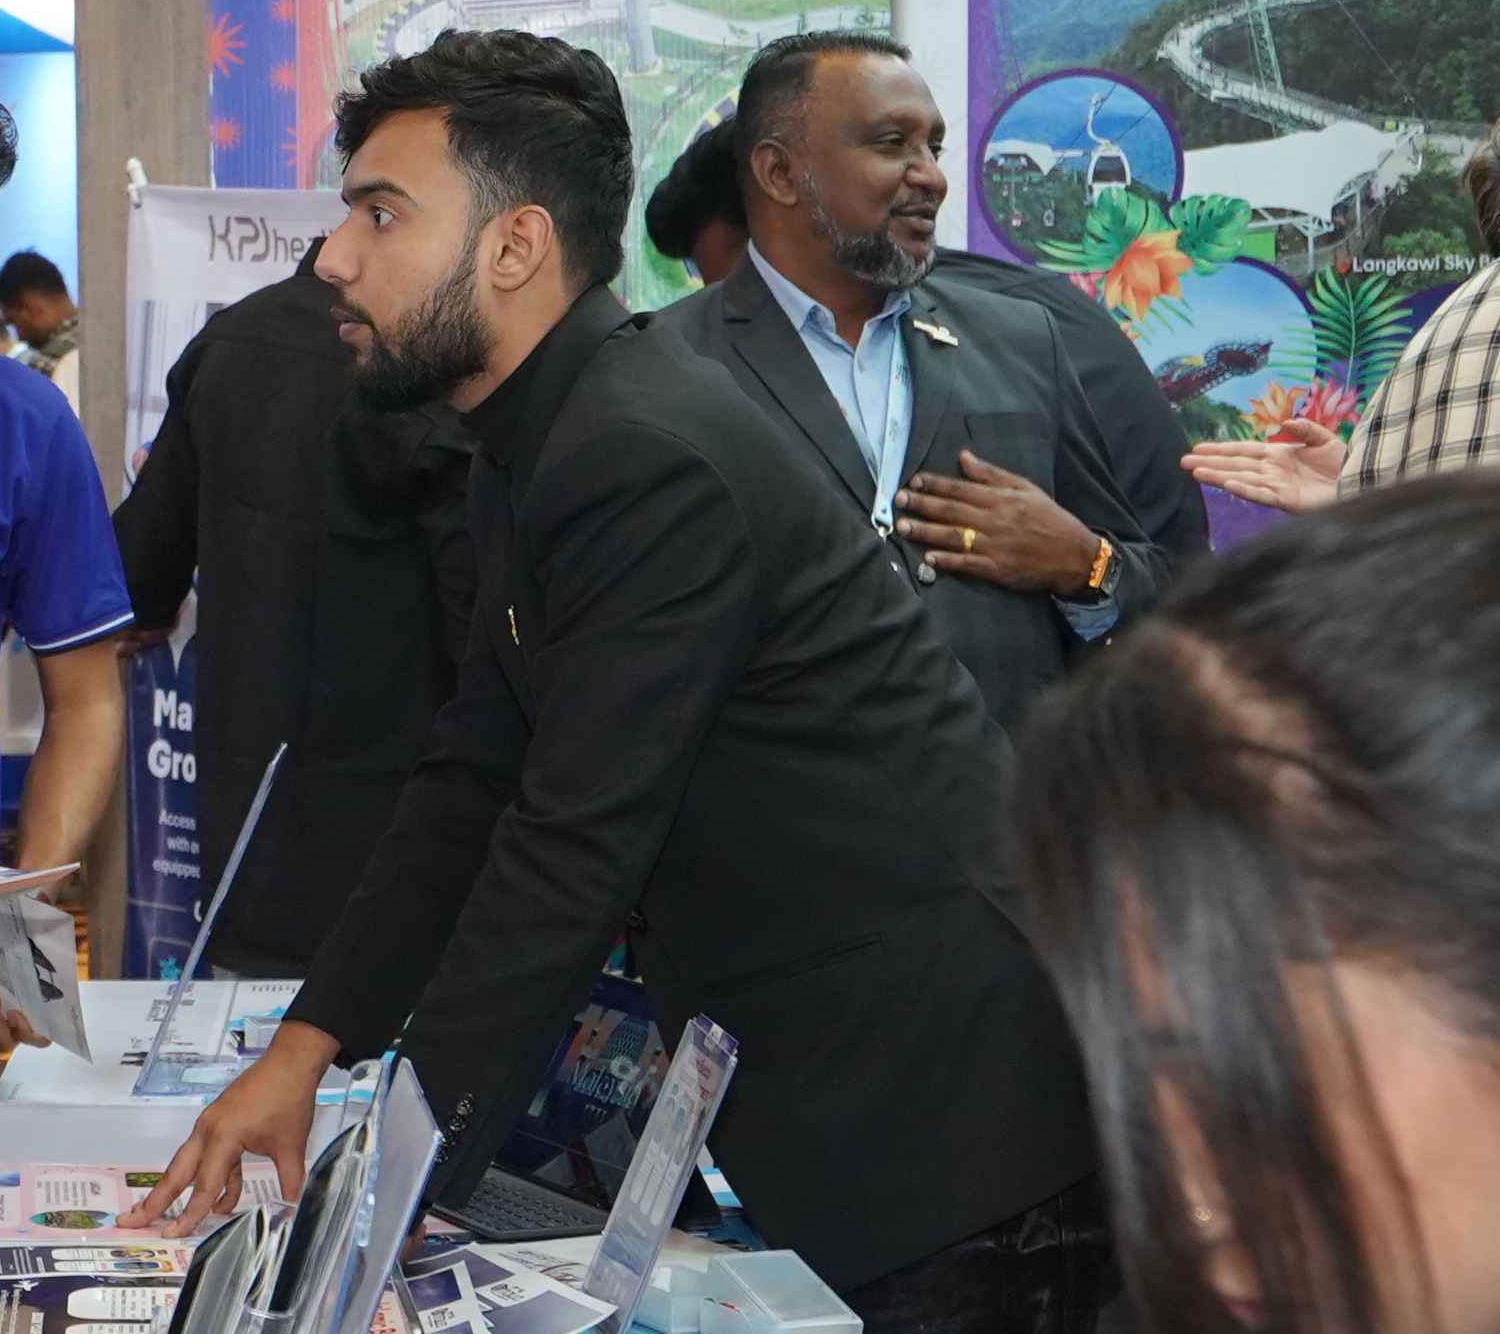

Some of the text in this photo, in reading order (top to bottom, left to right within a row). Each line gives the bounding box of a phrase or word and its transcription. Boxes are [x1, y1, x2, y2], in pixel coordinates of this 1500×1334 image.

[1352, 255, 1440, 277] Langkawi
[1443, 253, 1476, 275] Sky
[153, 688, 194, 733] Ma
[147, 738, 198, 784] Gro
